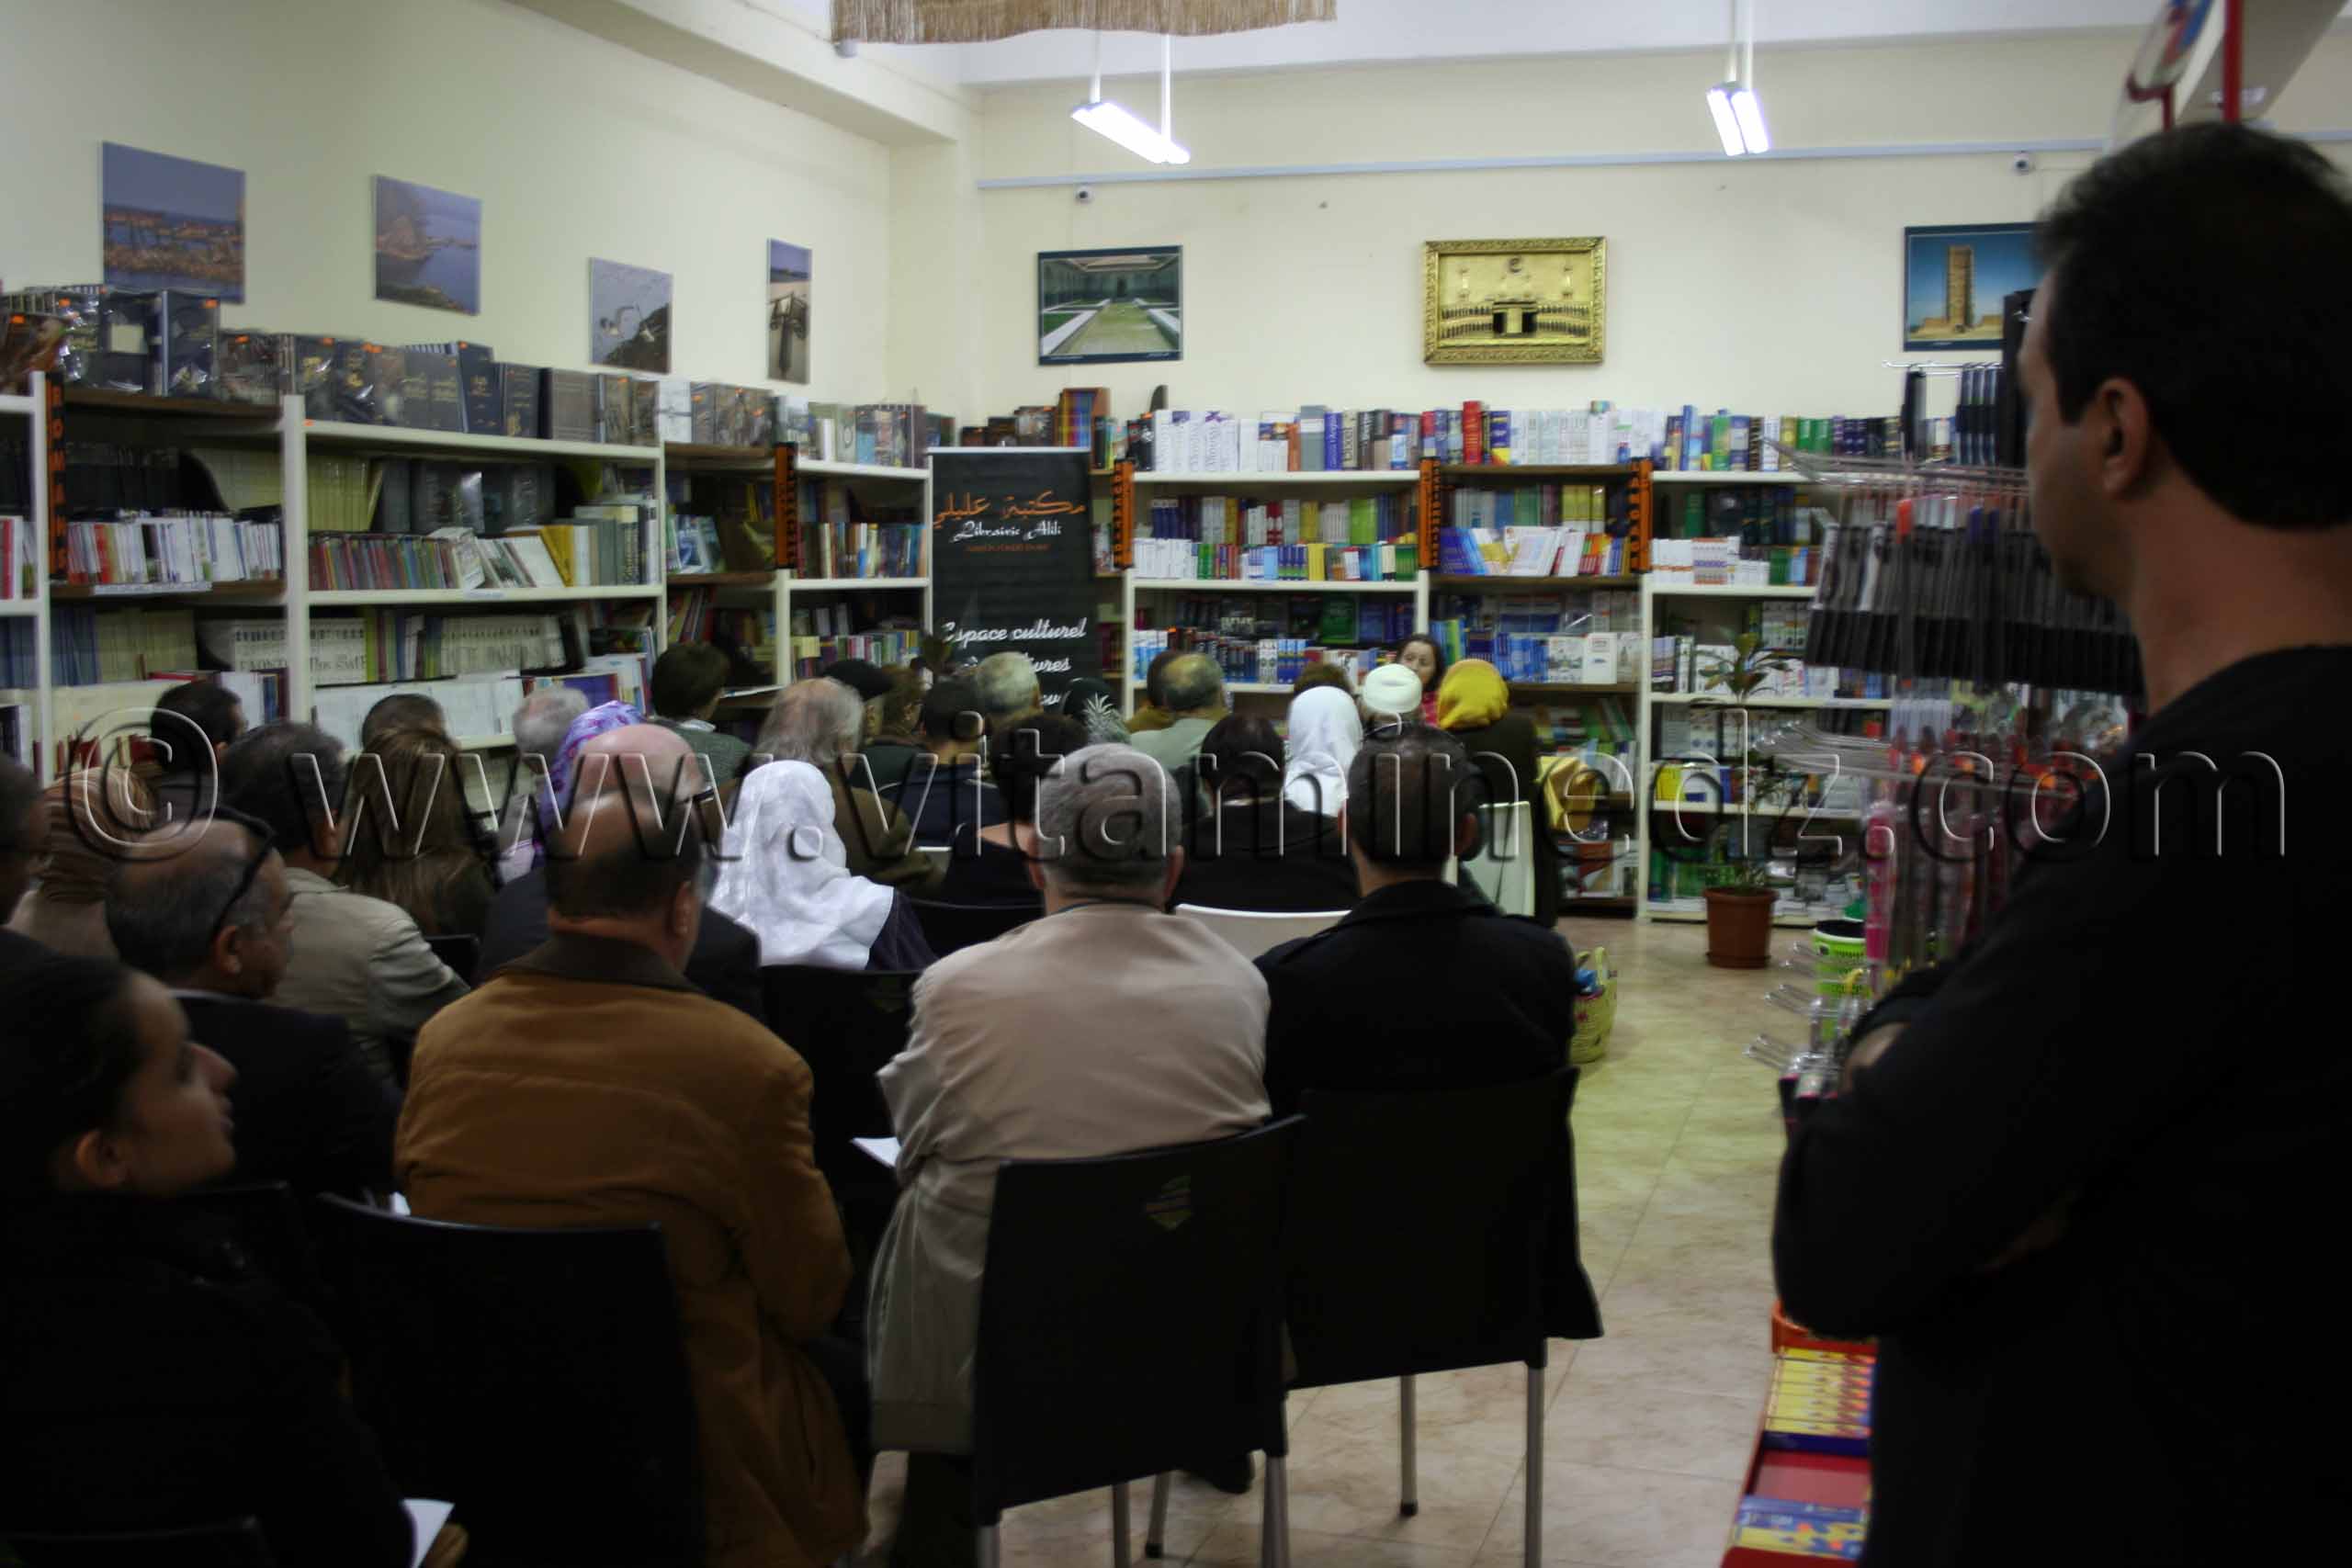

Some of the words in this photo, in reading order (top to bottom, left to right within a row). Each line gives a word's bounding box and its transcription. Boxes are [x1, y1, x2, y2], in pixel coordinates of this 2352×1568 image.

[1001, 490, 1088, 520] مكتبة
[949, 519, 1020, 544] Librairie
[1023, 519, 1063, 542] Alili
[1012, 616, 1088, 640] culturel
